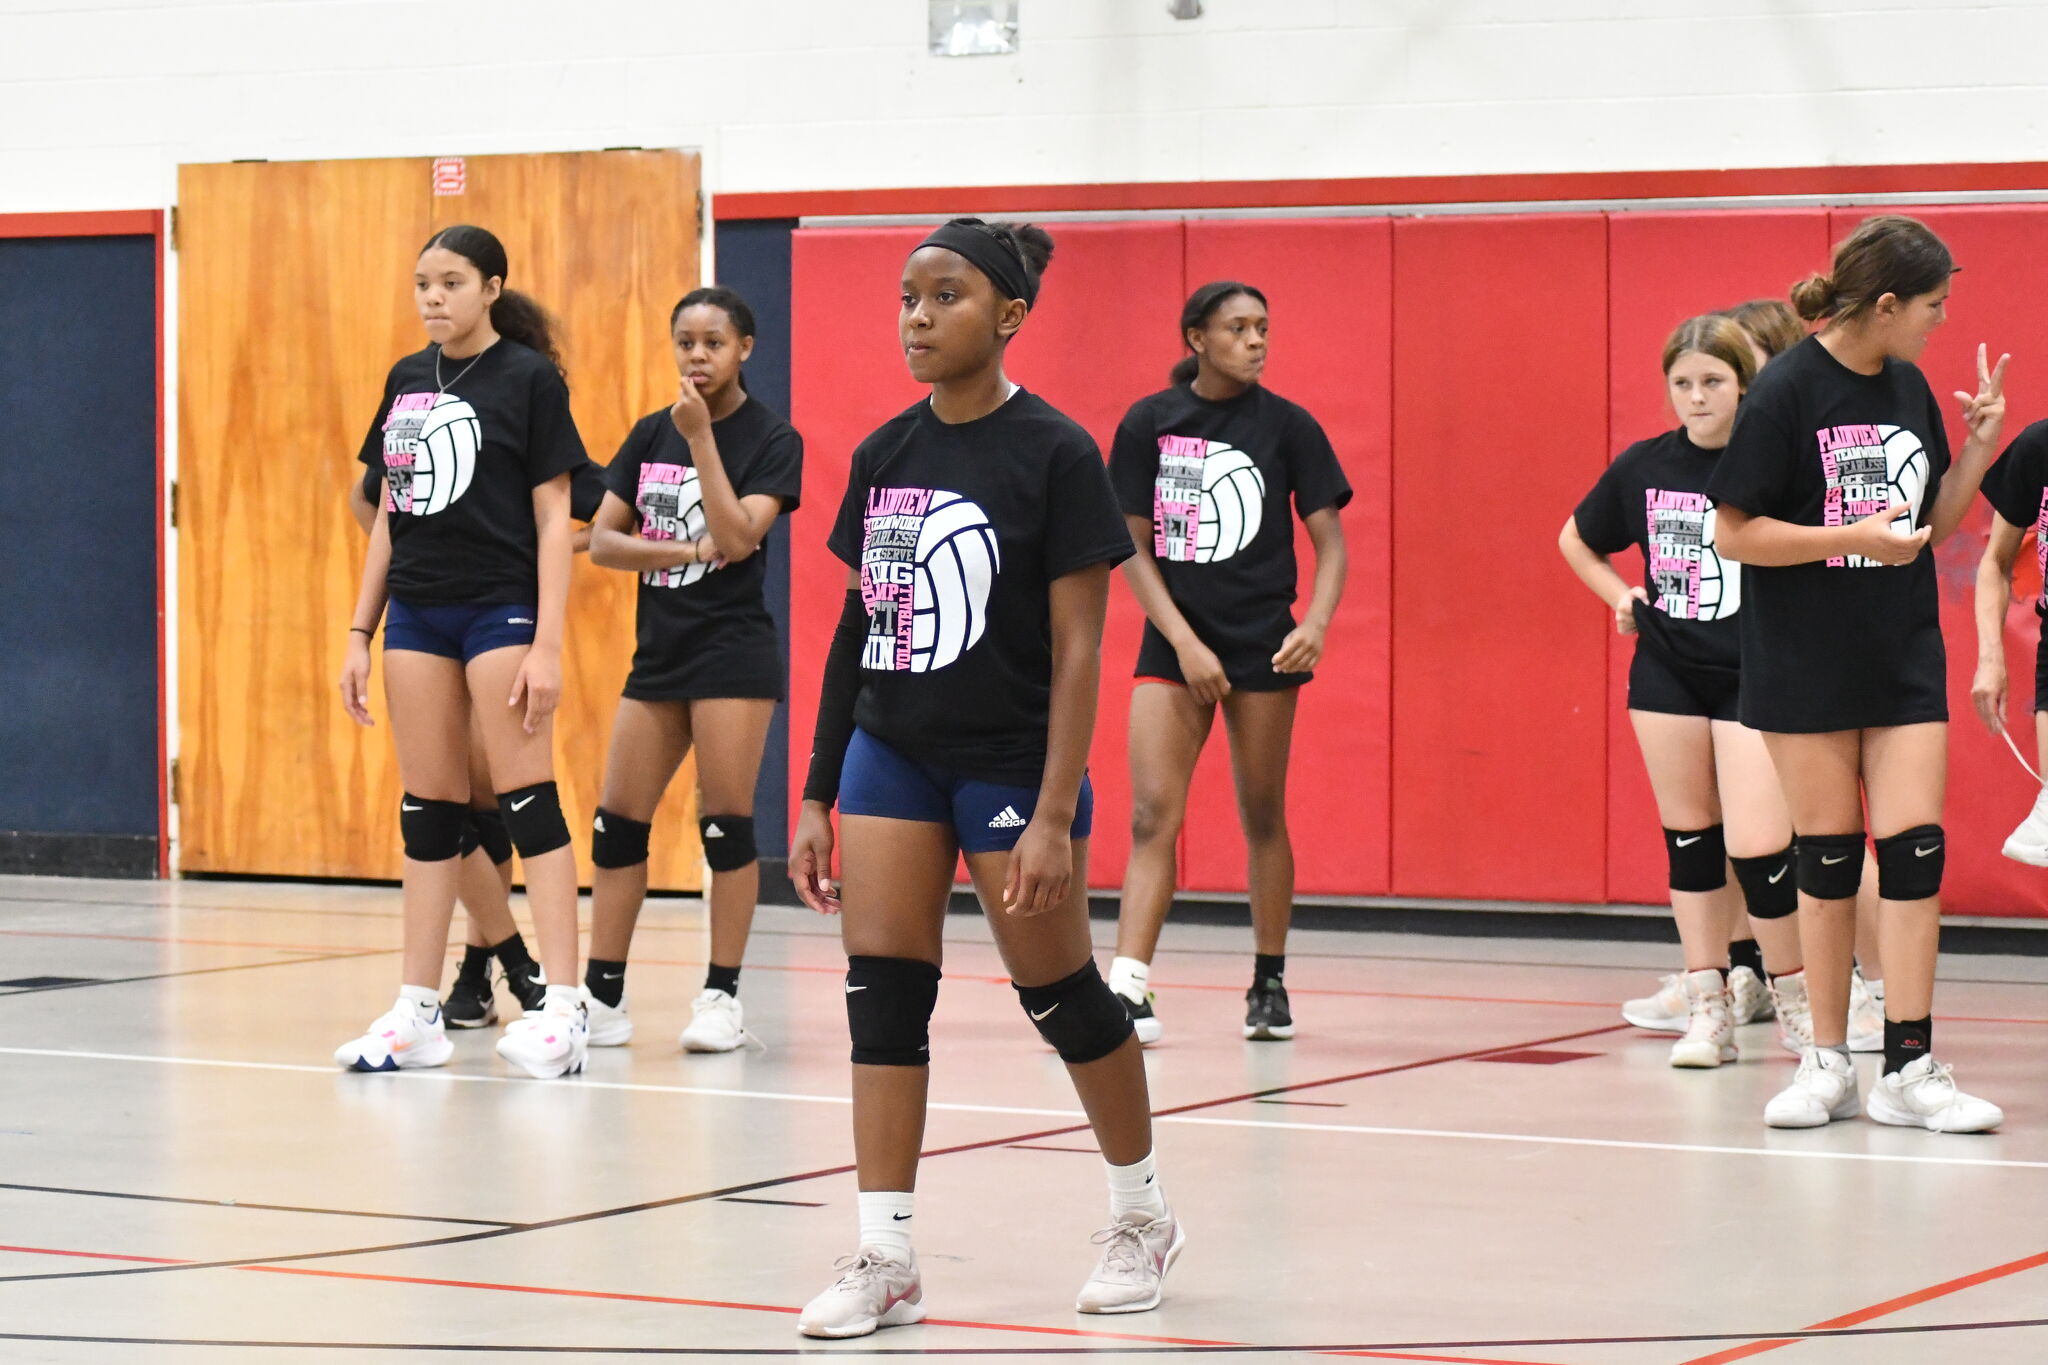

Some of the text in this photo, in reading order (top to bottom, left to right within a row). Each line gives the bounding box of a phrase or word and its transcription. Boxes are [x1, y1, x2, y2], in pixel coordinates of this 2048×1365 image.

[385, 438, 418, 455] DIG
[1837, 458, 1887, 476] FEARLESS
[1160, 487, 1201, 504] DIG
[1843, 482, 1888, 503] DIG
[1844, 500, 1881, 516] JUMP
[880, 547, 915, 562] SERVE
[1659, 543, 1702, 561] DIG
[1656, 570, 1691, 596] SET
[869, 600, 898, 636] ET
[895, 584, 914, 671] VOLLEYBALL
[988, 818, 1026, 828] adidas
